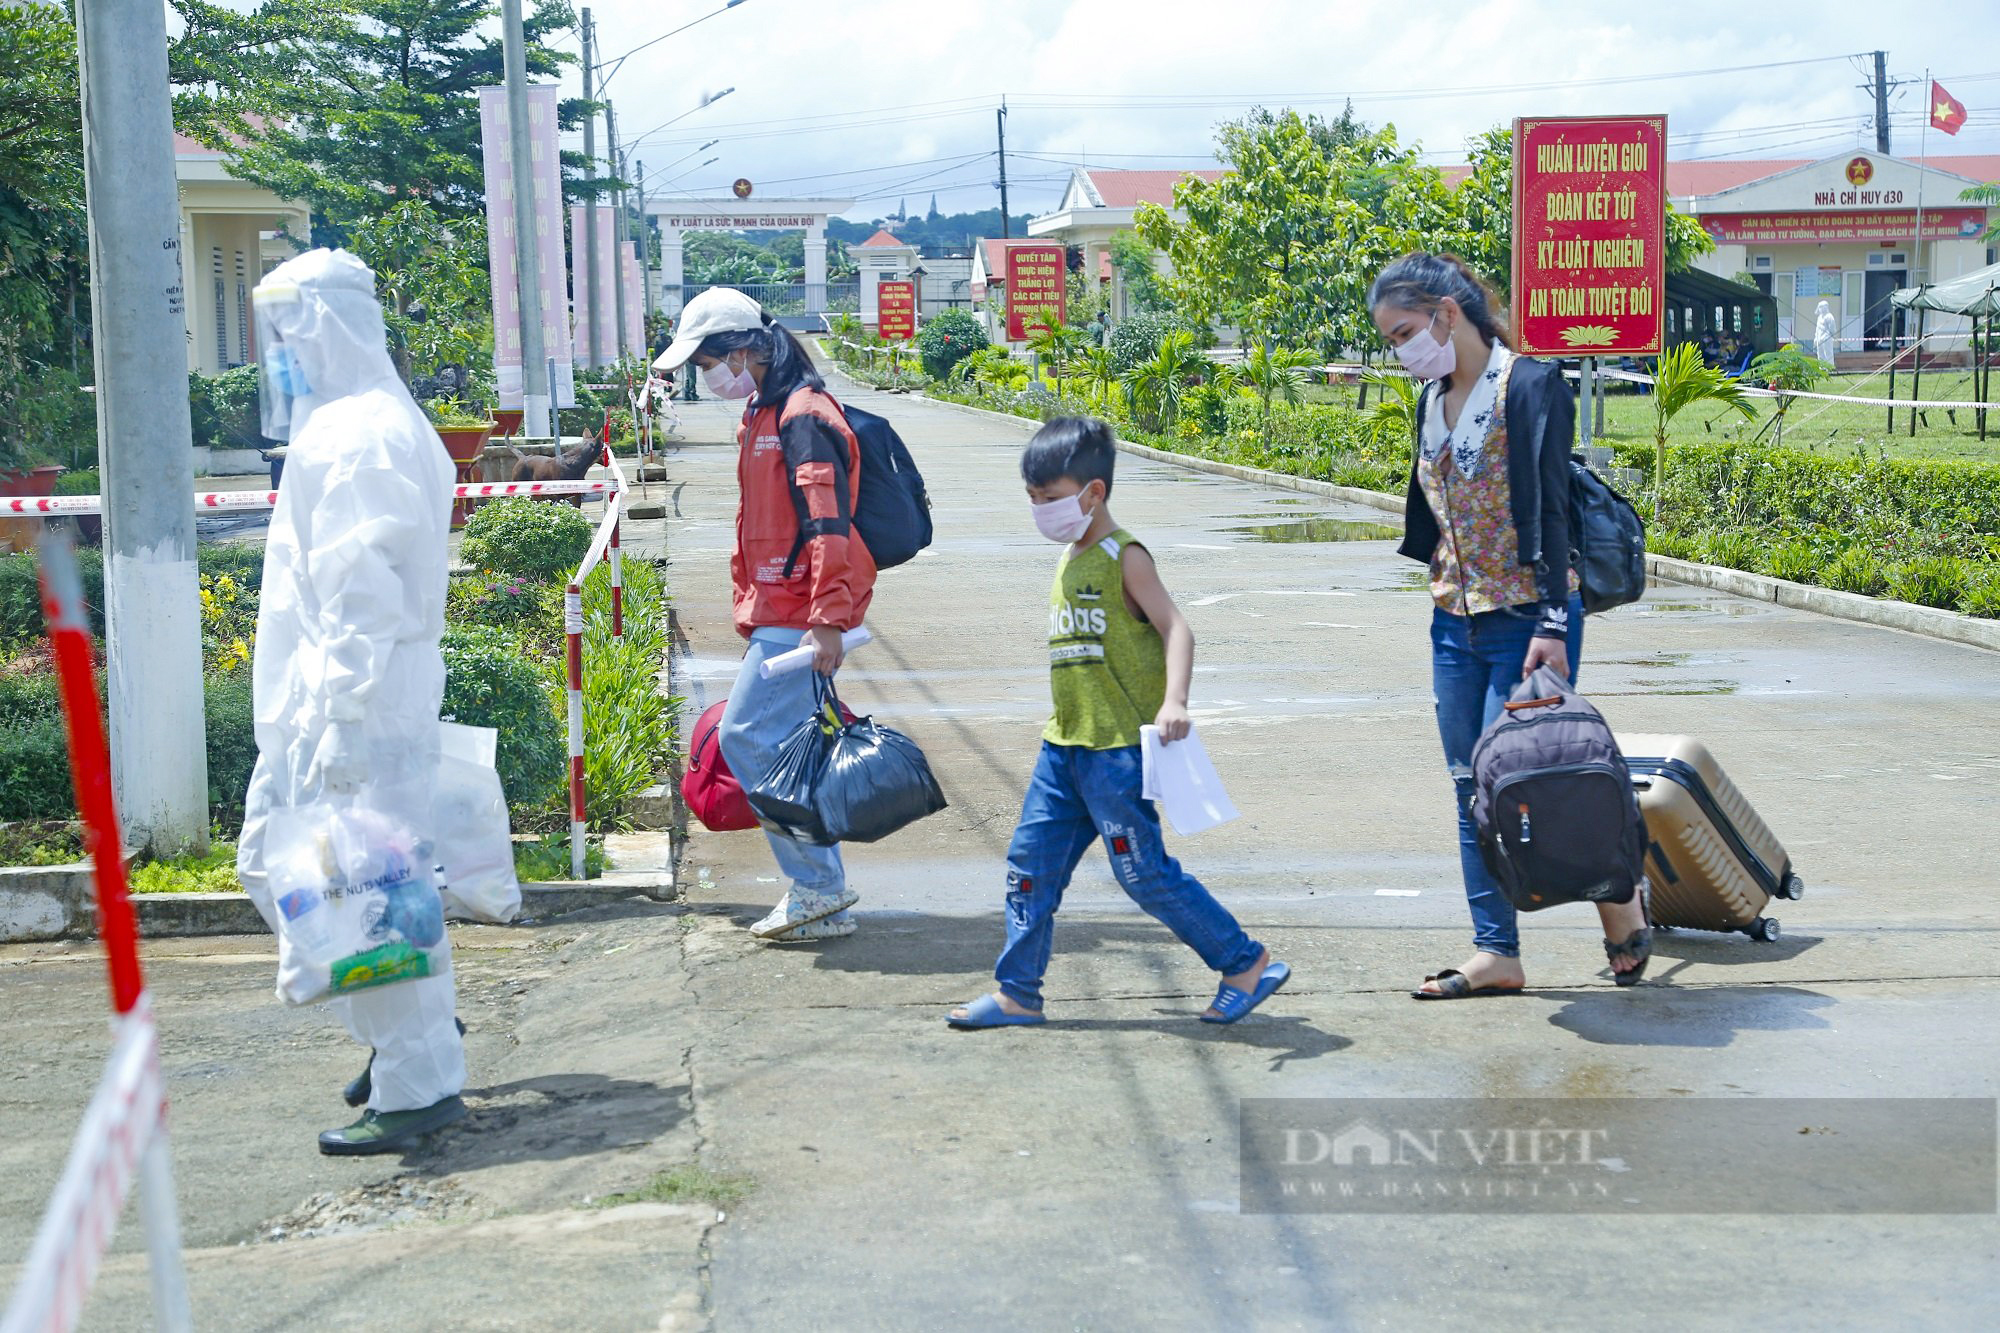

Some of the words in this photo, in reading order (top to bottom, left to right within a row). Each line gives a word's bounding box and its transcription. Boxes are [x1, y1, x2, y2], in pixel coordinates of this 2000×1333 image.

[1538, 133, 1573, 173] HUẤN
[1577, 137, 1617, 179] LUYỆN
[1622, 130, 1648, 172] GIỎI
[1546, 186, 1582, 221] ĐOÀN
[1586, 181, 1610, 220] KẾT
[1614, 181, 1636, 220] TỐT
[1815, 188, 1835, 205] NHÀ
[1840, 185, 1856, 205] CHỈ
[1861, 191, 1881, 204] HUY
[1884, 190, 1903, 204] d30
[683, 216, 702, 228] LUẬT
[704, 216, 714, 227] LÀ
[716, 215, 731, 227] SỨC
[734, 218, 757, 229] MẠNH
[760, 214, 775, 226] CỦA
[777, 215, 799, 227] QUÂN
[801, 215, 814, 228] ĐỘI
[1757, 231, 1776, 239] THEO
[1857, 228, 1884, 237] PHONG
[1938, 226, 1959, 235] MINH
[1855, 216, 1864, 225] 30
[1538, 228, 1554, 269] KỶ
[1558, 234, 1590, 276] LUẬT
[1594, 233, 1644, 269] NGHIÊM
[1529, 289, 1547, 317] AN
[1551, 282, 1585, 316] TOÀN
[1589, 281, 1627, 322] TUYỆT
[1630, 276, 1652, 316] ĐỐI
[323, 887, 343, 900] THE
[374, 867, 411, 889] VALLEY
